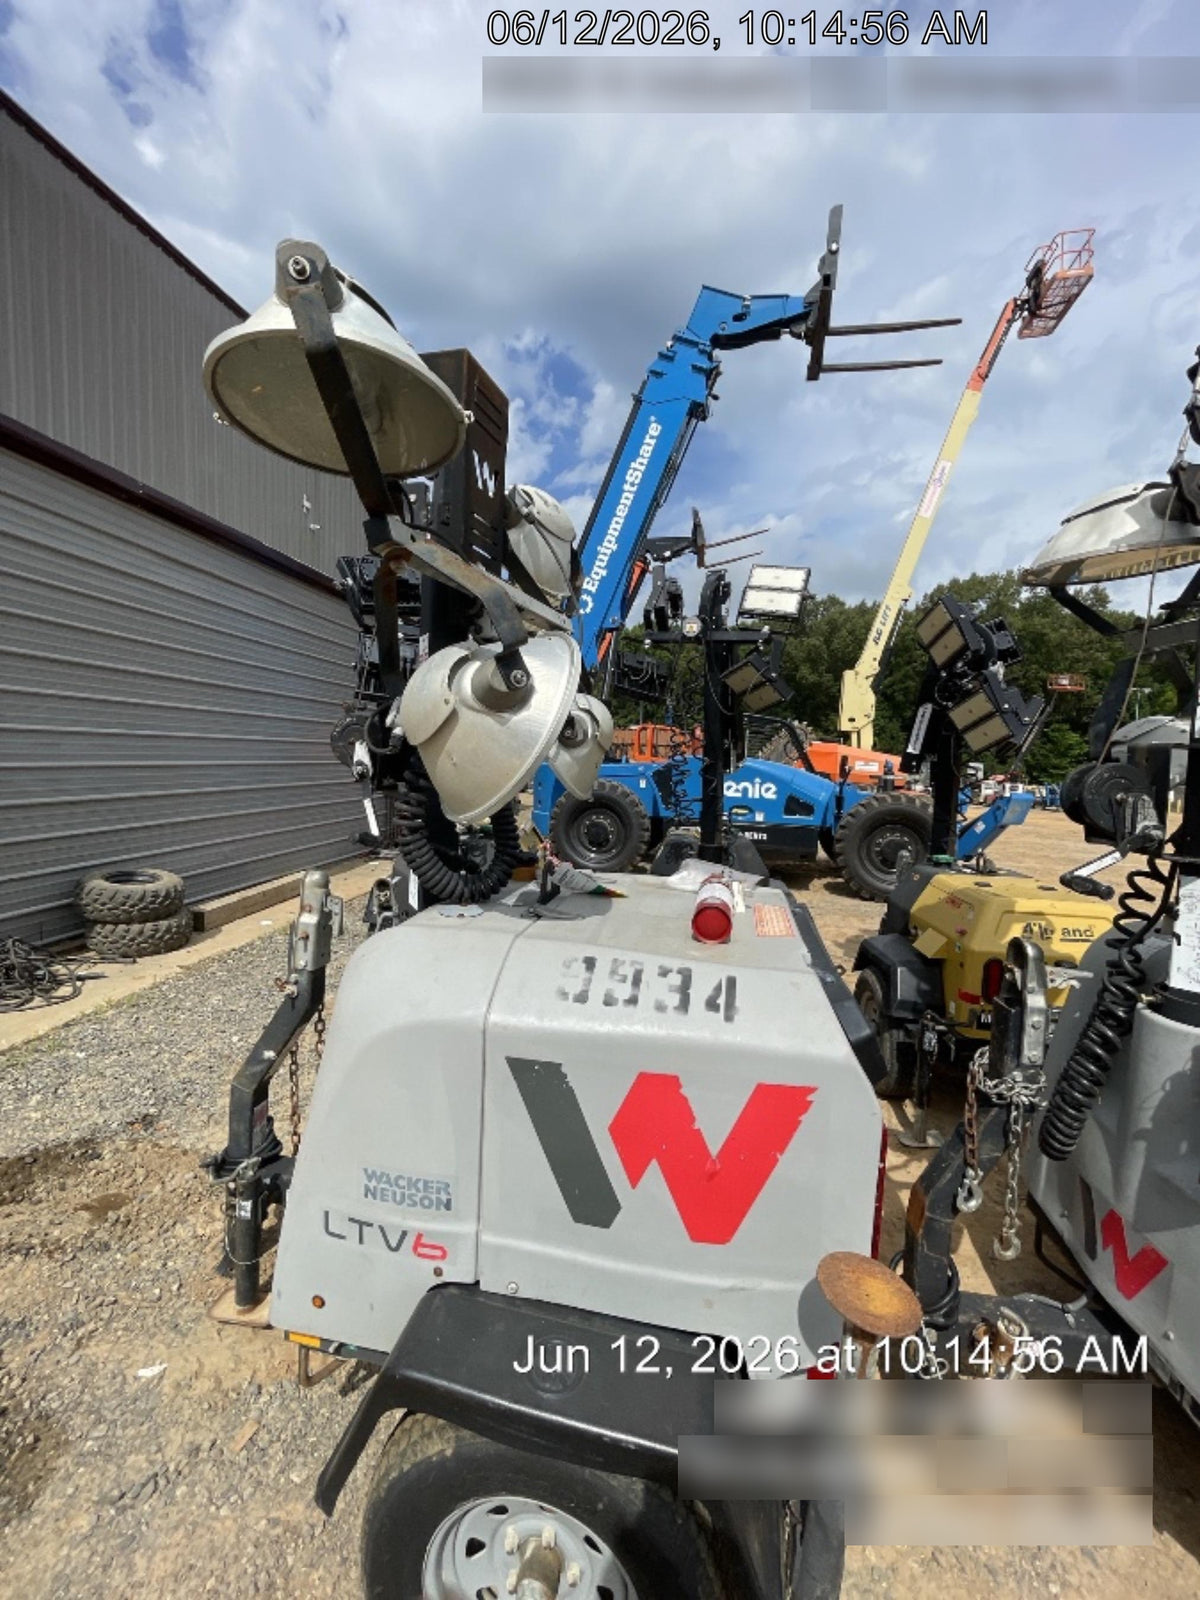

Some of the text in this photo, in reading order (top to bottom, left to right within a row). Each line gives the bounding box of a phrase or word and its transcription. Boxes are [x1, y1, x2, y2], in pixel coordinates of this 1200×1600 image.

[583, 421, 662, 594] EquipmentShare
[723, 777, 778, 800] enie
[363, 1167, 451, 1195] WACKER
[363, 1183, 453, 1211] NEUSON
[323, 1210, 448, 1261] LTV6
